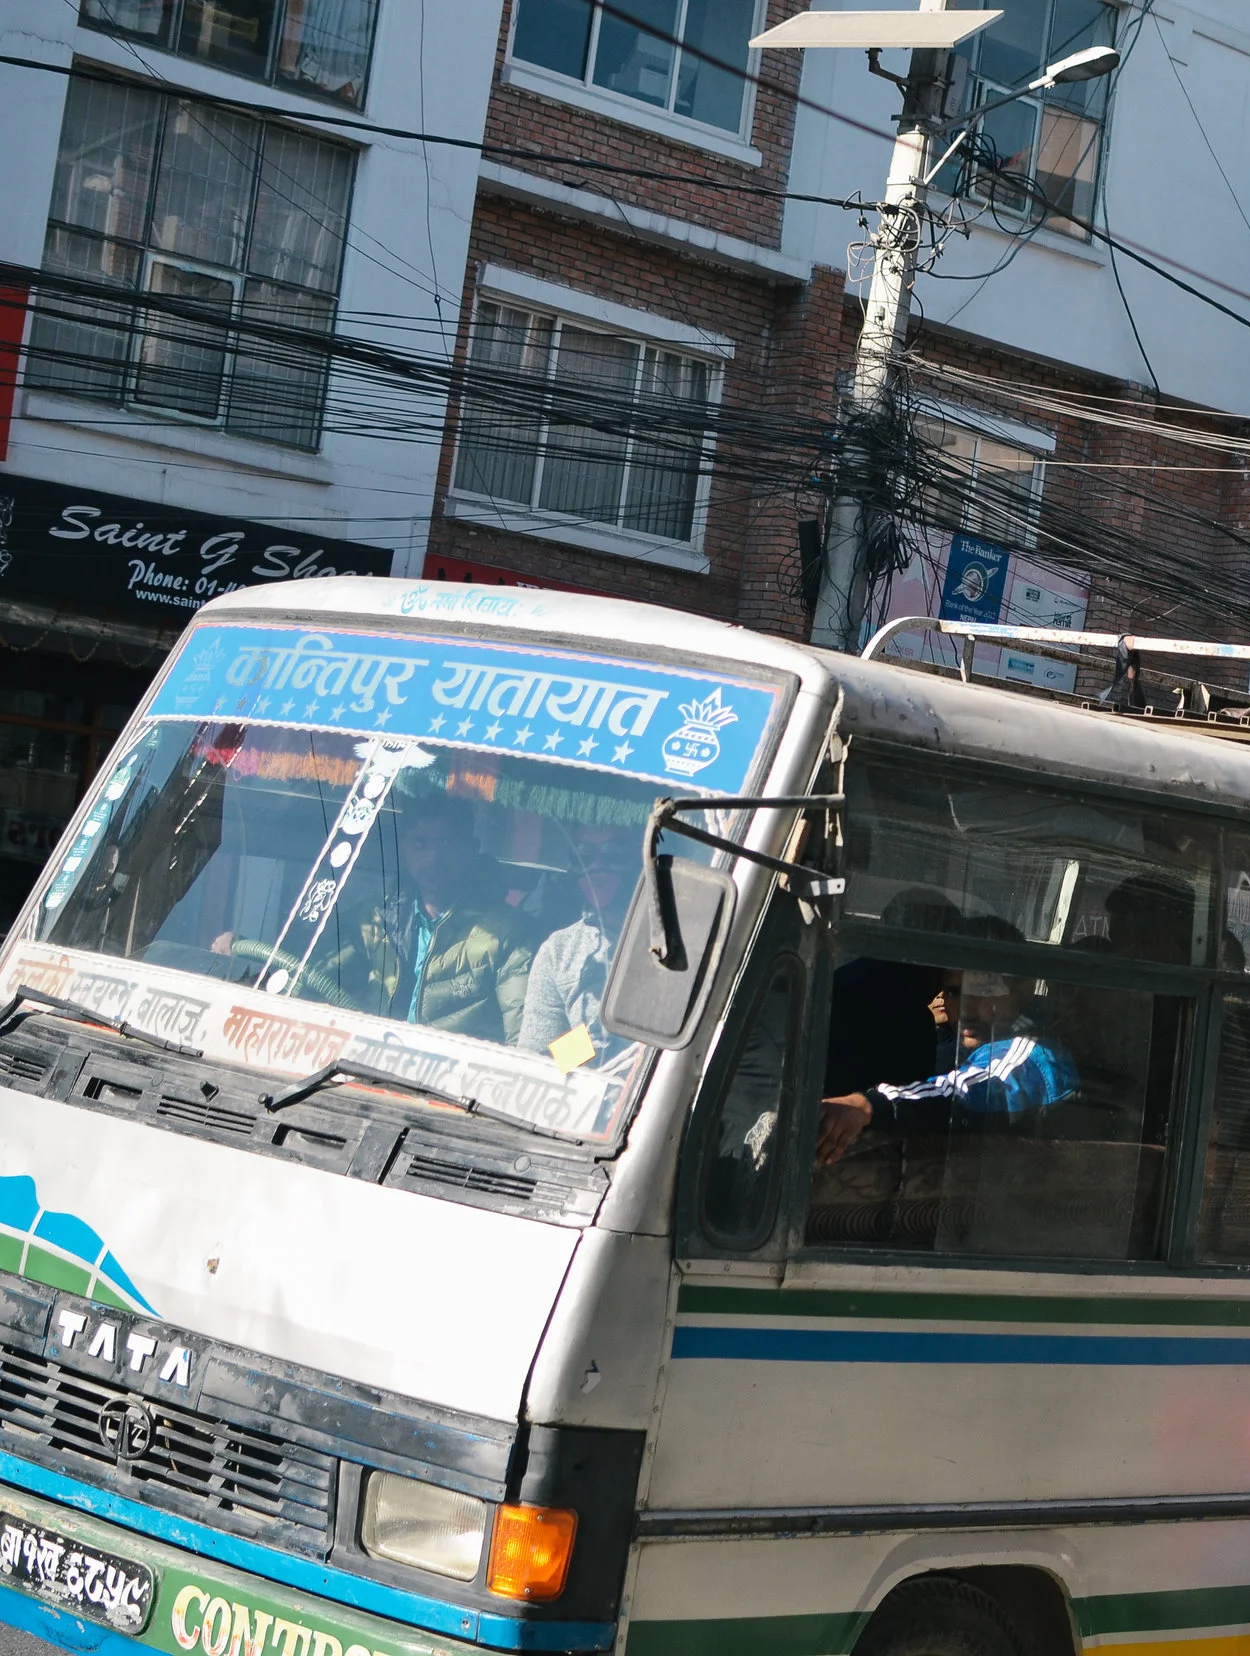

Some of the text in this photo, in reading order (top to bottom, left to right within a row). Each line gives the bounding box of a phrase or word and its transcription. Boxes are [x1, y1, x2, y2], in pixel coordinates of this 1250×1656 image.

[49, 505, 187, 556] Saint
[251, 545, 374, 579] Sho
[127, 559, 190, 591] Phone:
[960, 540, 1003, 562] The Banker
[225, 632, 670, 739] कान्तिपुर यातायात
[58, 1309, 193, 1388] TATA
